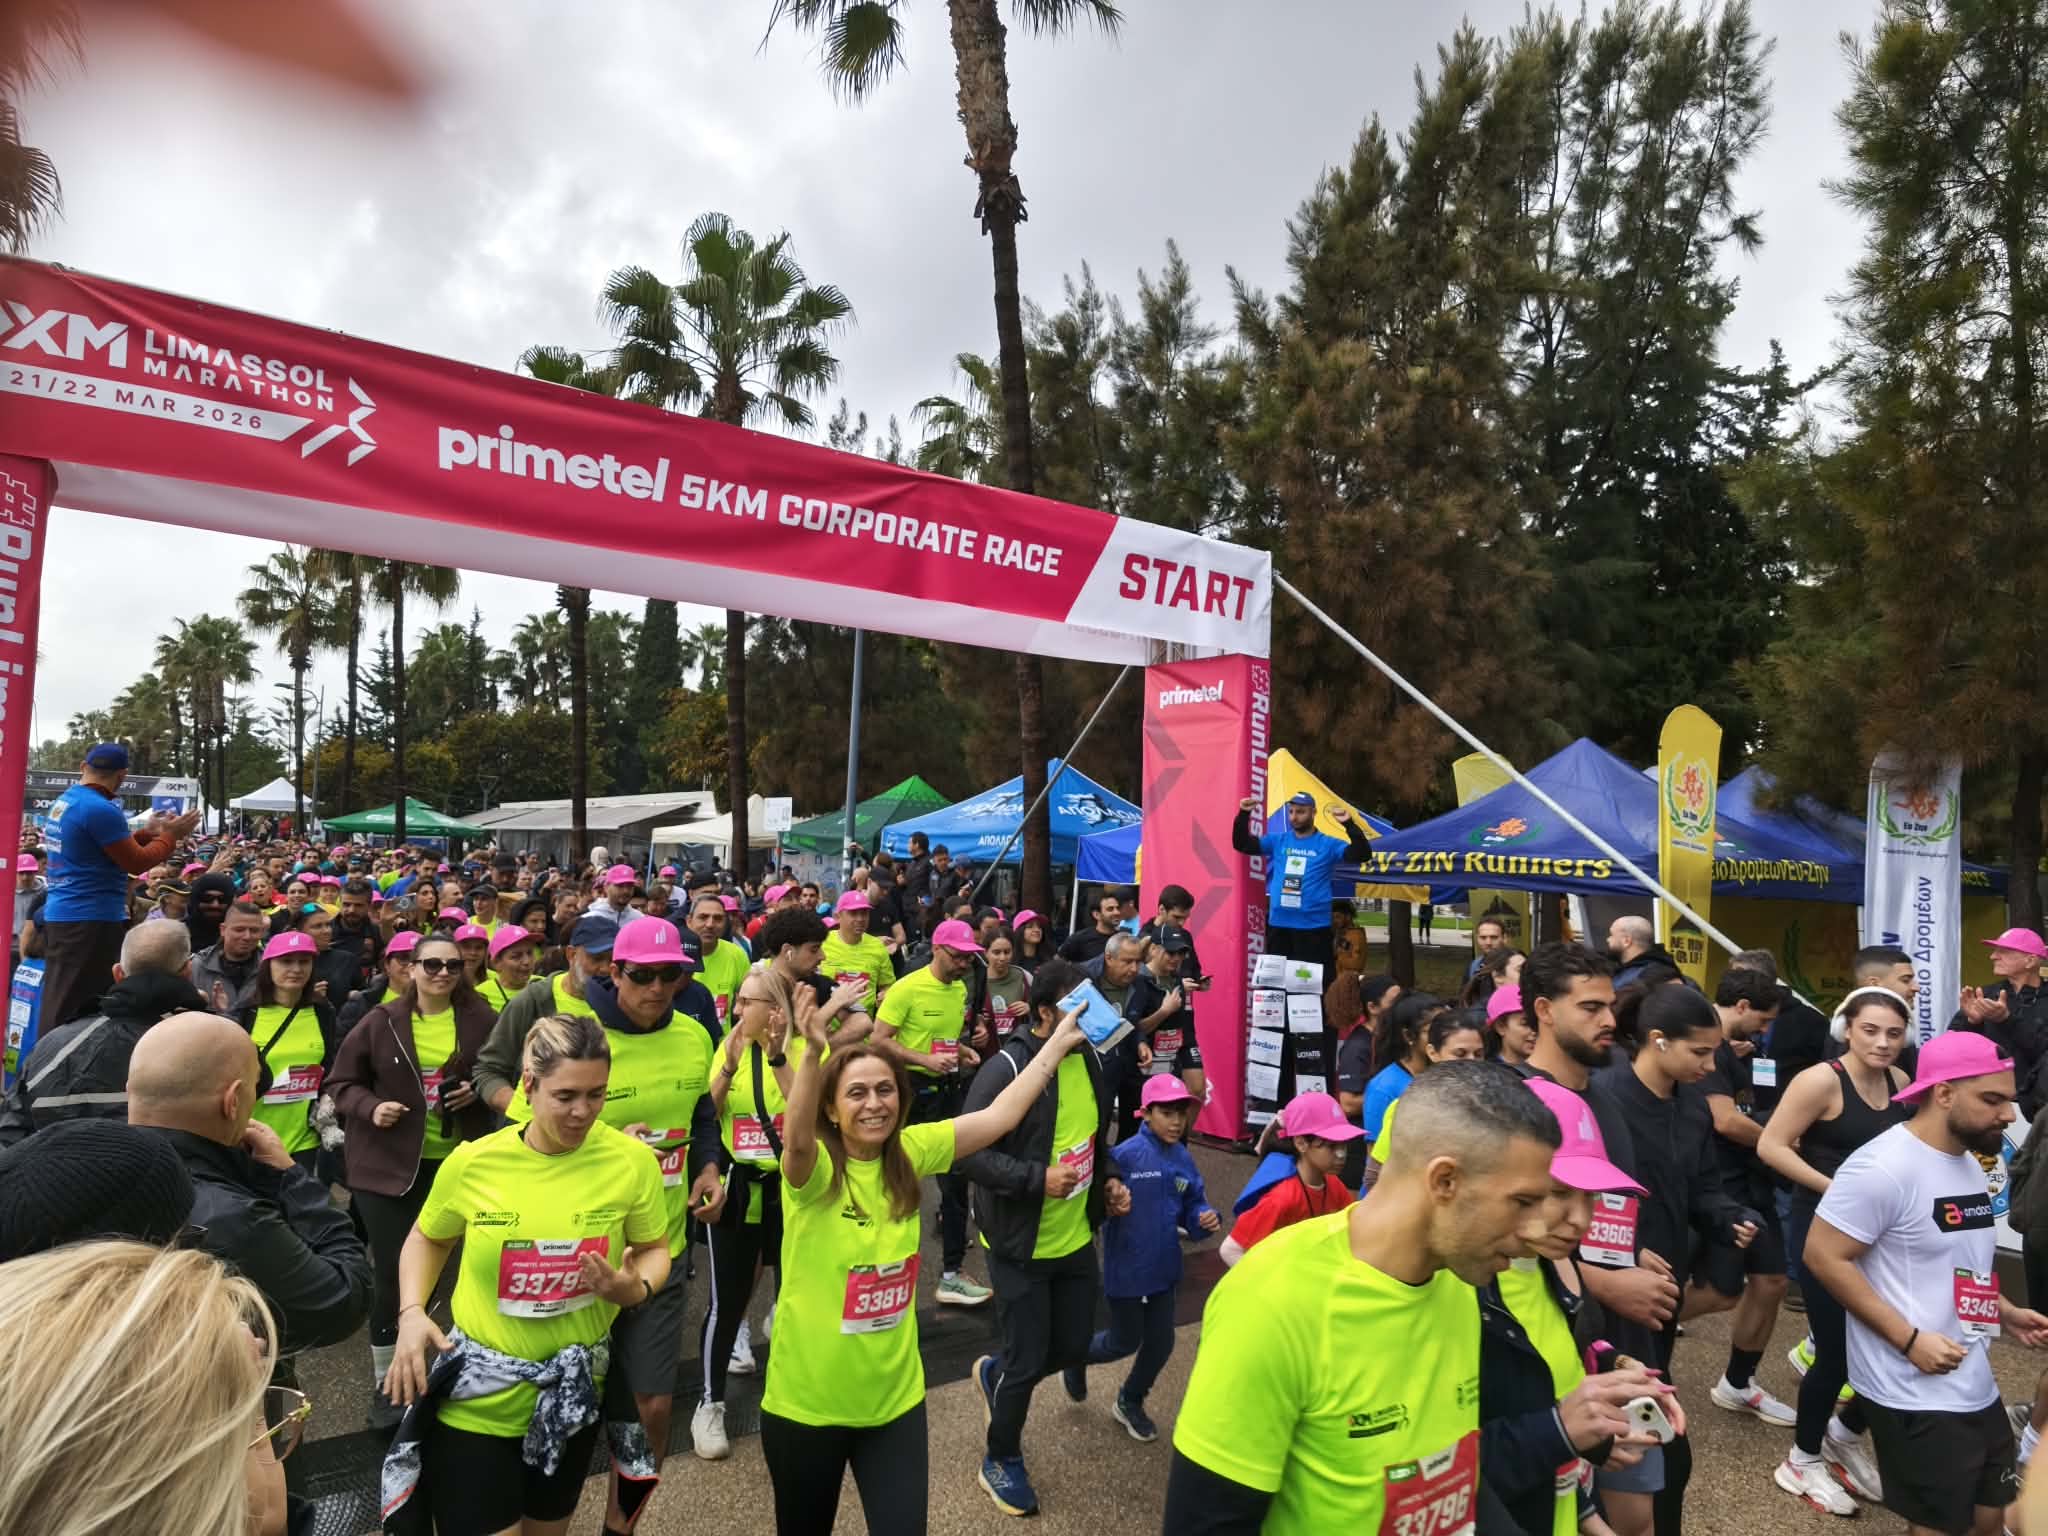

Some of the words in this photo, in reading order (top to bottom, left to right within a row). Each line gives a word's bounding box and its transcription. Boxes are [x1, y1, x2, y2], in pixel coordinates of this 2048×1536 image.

[143, 357, 334, 412] MARATHON
[144, 328, 334, 394] LIMASSOL
[9, 369, 98, 399] 21/22
[115, 388, 177, 413] MAR
[192, 403, 263, 430] 2026
[437, 425, 669, 503] primetel
[679, 474, 767, 521] 5KM
[779, 494, 979, 561] CORPORATE
[983, 533, 1063, 578] RACE
[1119, 552, 1255, 622] START
[1159, 680, 1224, 709] primetel
[1359, 851, 1460, 874] EV-ZIN
[1463, 852, 1616, 879] Runners
